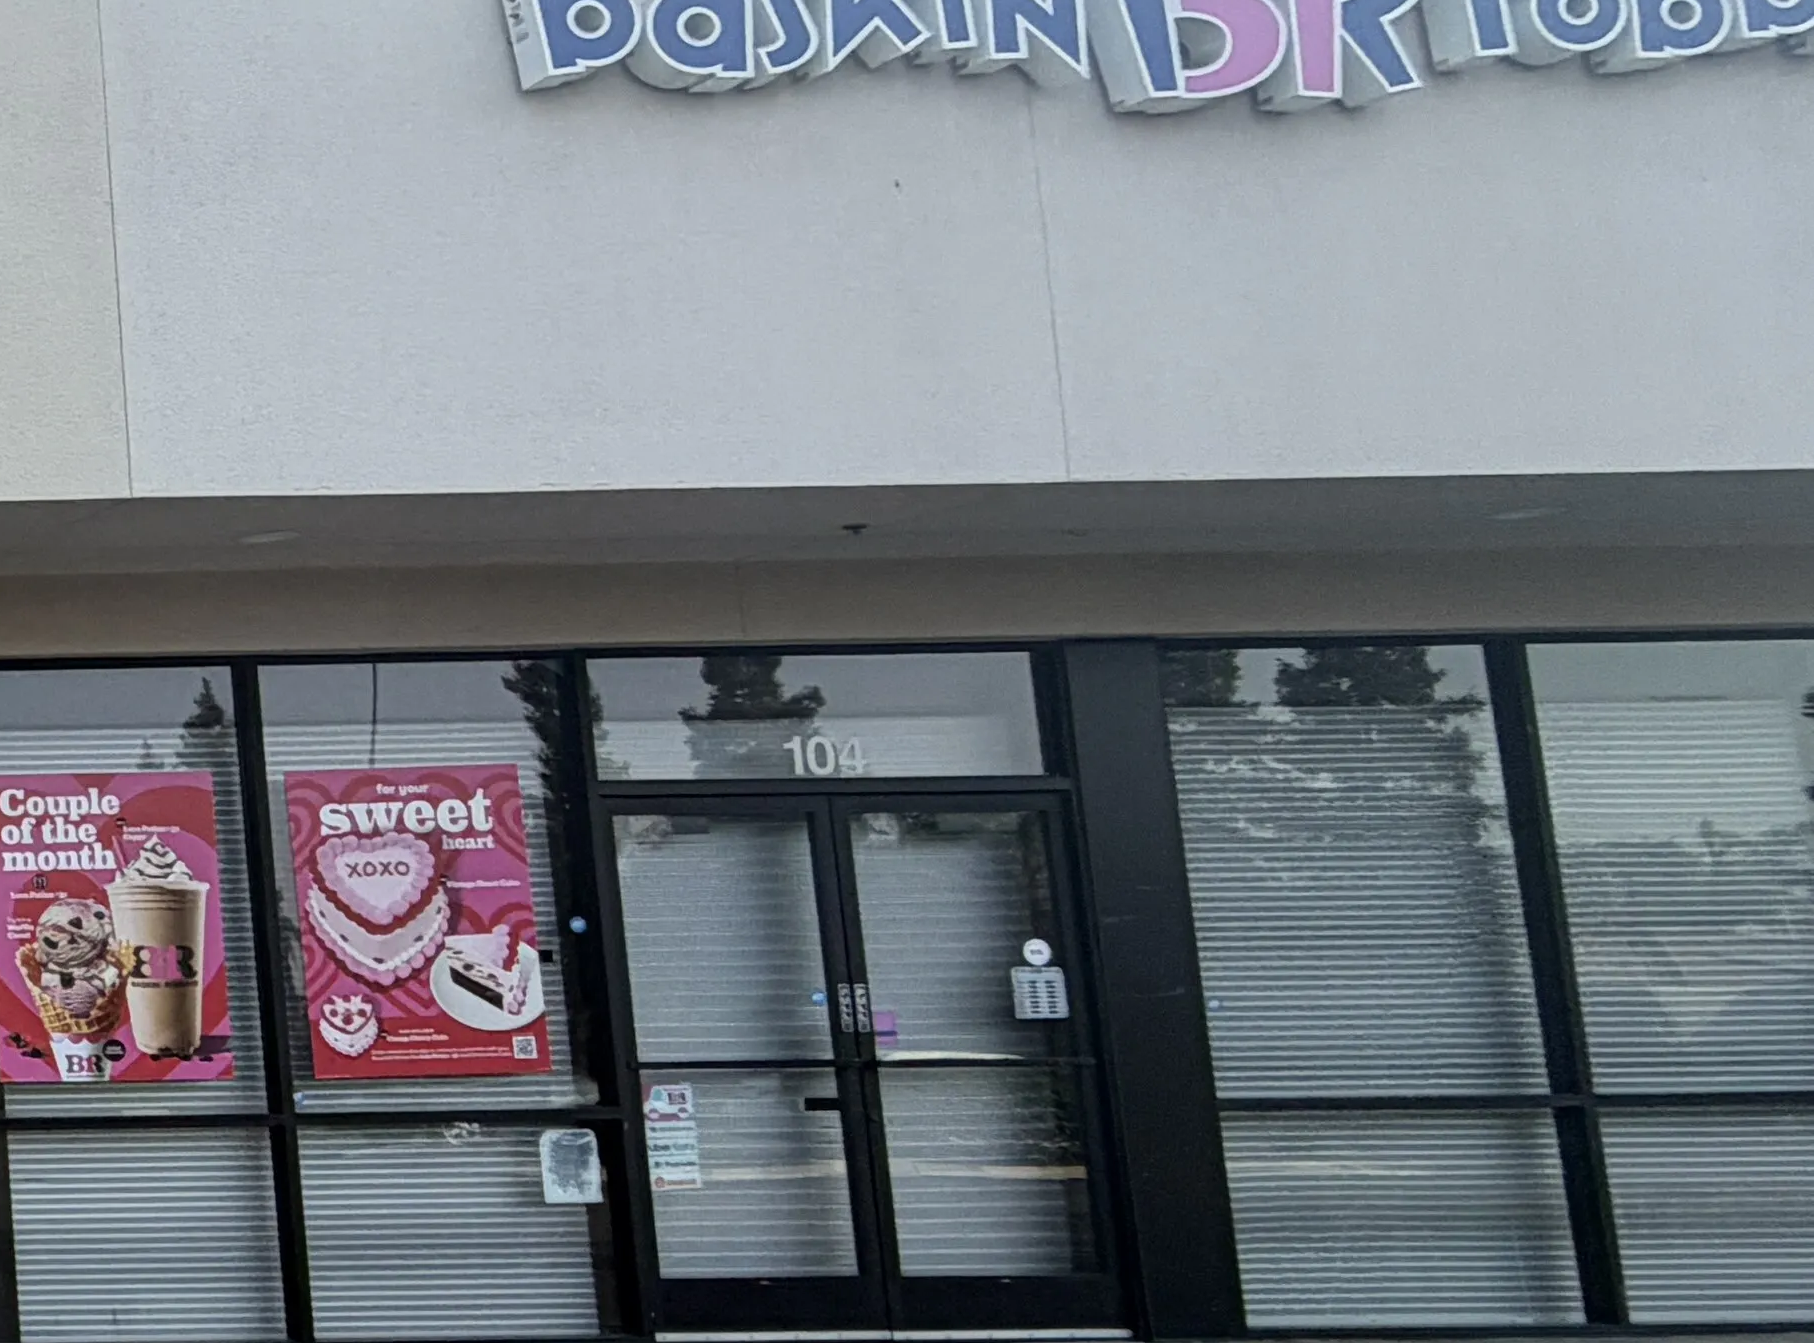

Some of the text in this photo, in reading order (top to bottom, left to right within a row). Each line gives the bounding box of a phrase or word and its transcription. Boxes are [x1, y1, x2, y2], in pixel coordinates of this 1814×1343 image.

[782, 735, 867, 777] 104
[376, 783, 430, 797] for your
[0, 787, 121, 821] Couple
[319, 788, 493, 836] sweet
[1, 817, 36, 844] of
[41, 817, 97, 844] the
[442, 835, 495, 850] heart
[2, 842, 117, 871] month
[345, 860, 410, 878] XOXO
[65, 1054, 105, 1073] BR
